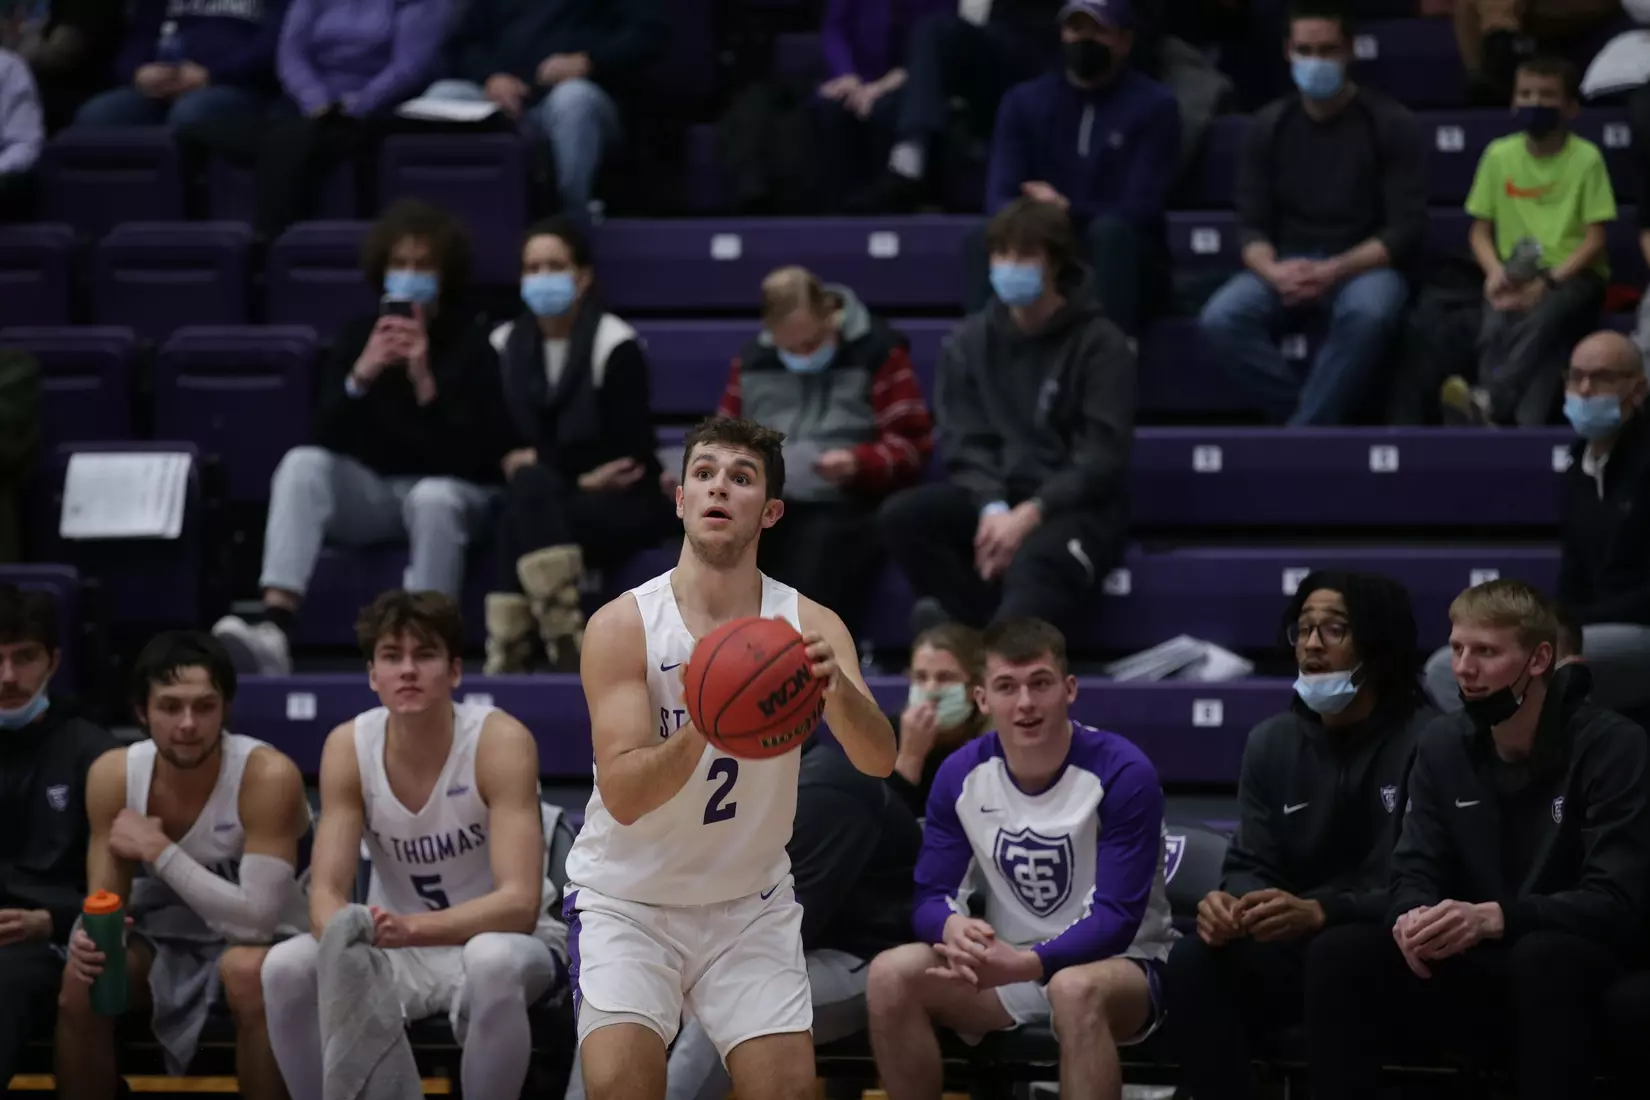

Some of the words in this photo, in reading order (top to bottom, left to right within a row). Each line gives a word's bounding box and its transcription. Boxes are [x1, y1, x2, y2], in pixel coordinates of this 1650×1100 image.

[757, 663, 811, 717] NCAA
[703, 757, 739, 825] 2
[391, 823, 485, 864] THOMAS
[410, 874, 451, 911] 5
